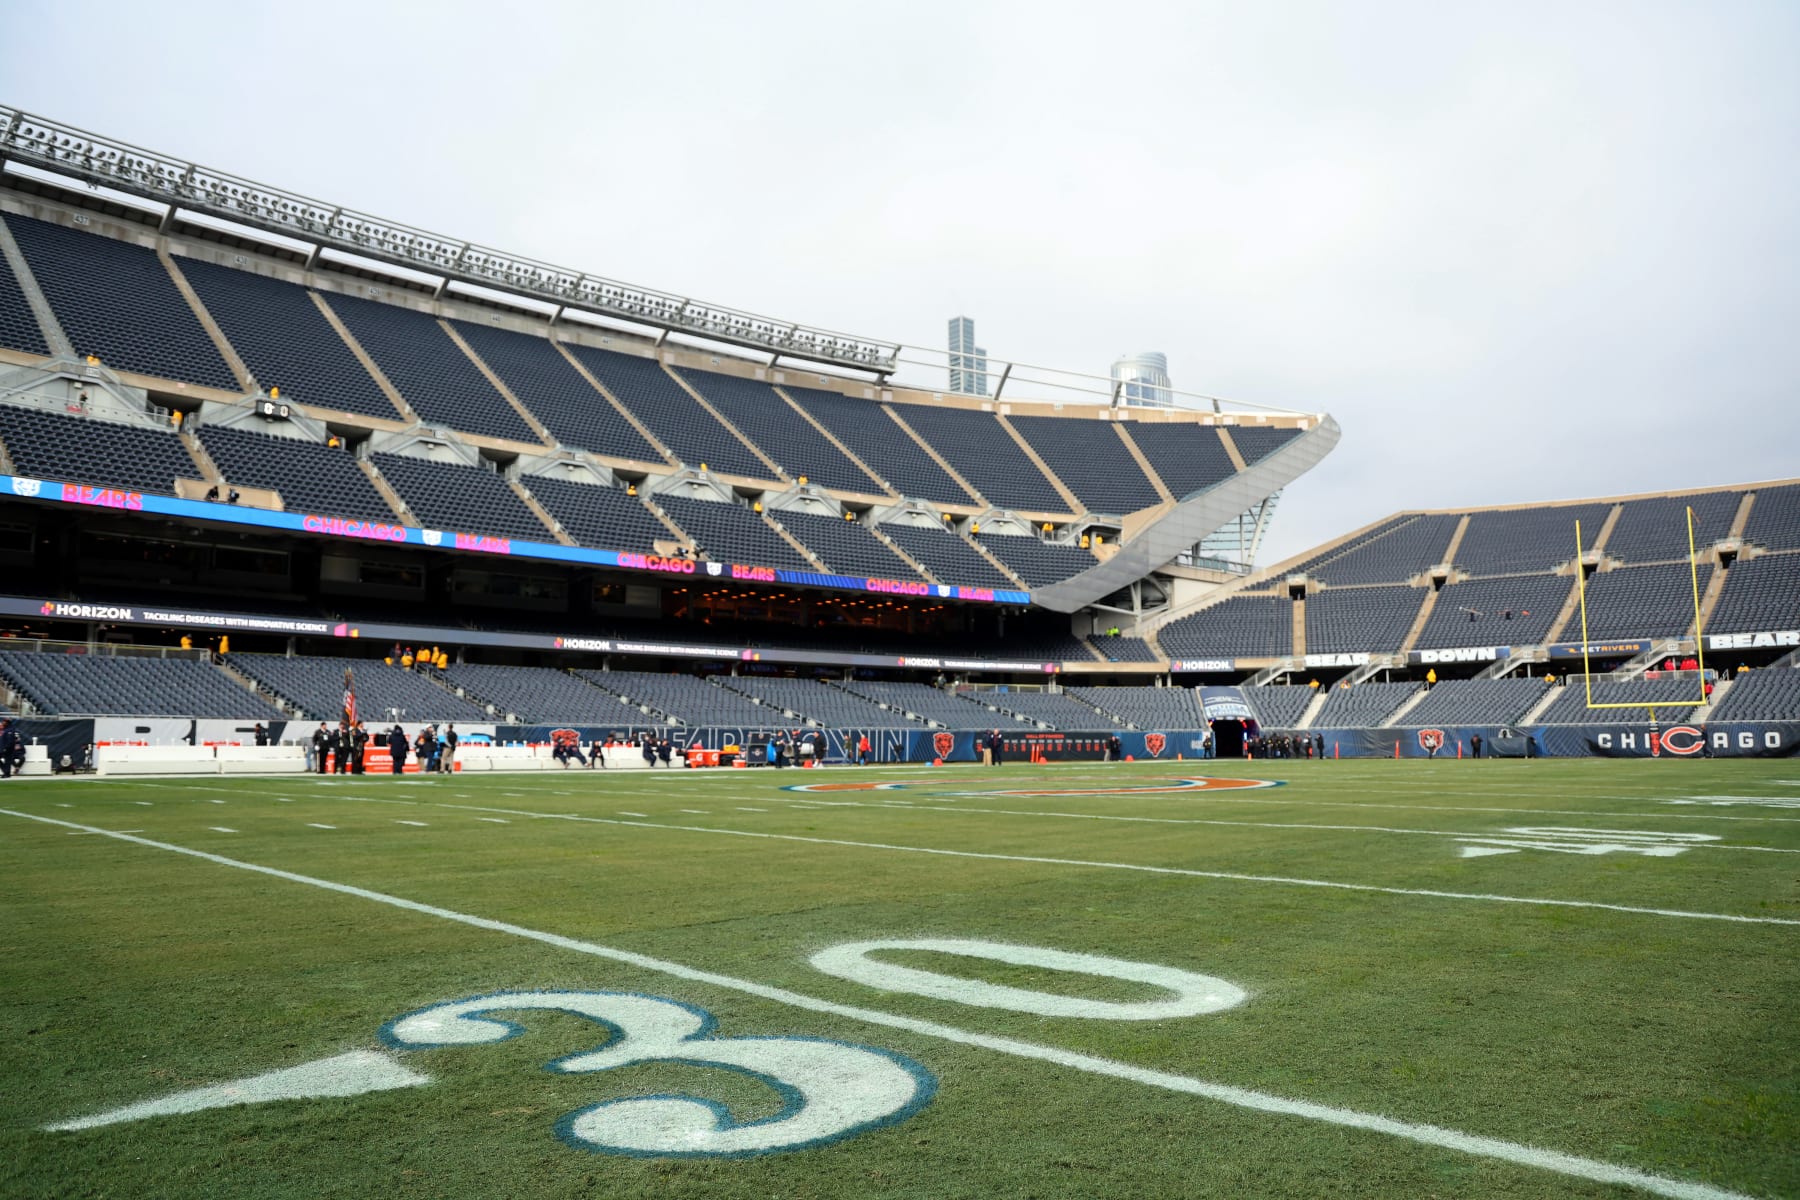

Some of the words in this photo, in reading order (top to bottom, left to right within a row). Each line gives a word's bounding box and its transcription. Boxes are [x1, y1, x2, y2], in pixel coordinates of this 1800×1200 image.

[74, 214, 89, 224] 437
[62, 483, 143, 510] BEARS
[303, 515, 407, 542] CHICAGO
[455, 532, 511, 554] BEARS
[617, 552, 696, 574] CHICAGO
[732, 564, 775, 582] BEARS
[866, 578, 929, 596] CHICAGO
[143, 612, 185, 622] TACKLING
[185, 615, 225, 625] DISEASES
[225, 617, 248, 626] WITH
[296, 622, 327, 632] SCIENCE
[1710, 632, 1800, 650] BEAR
[1305, 654, 1370, 667] BEAR
[1421, 648, 1496, 663] DOWN
[1597, 727, 1781, 754] CHICAGO
